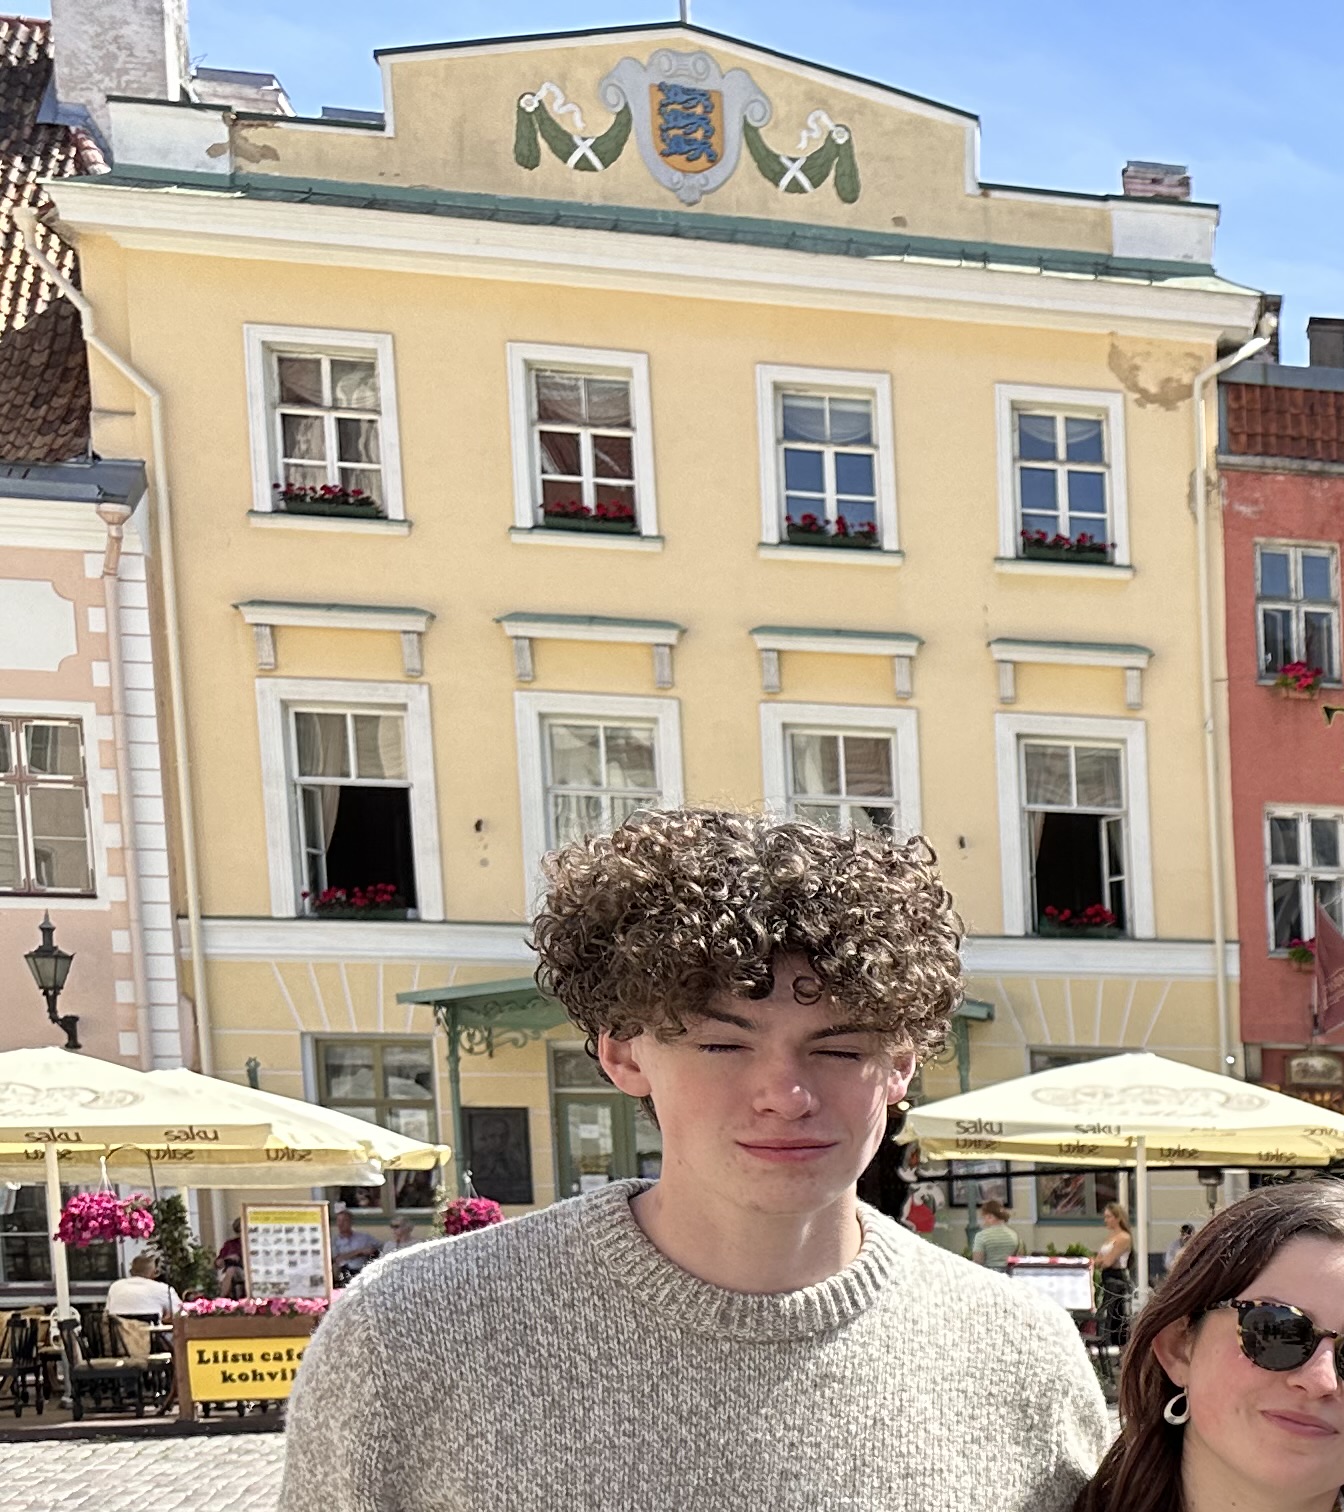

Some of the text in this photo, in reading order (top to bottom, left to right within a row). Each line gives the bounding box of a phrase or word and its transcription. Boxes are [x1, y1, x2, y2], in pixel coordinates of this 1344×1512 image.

[164, 1125, 219, 1142] saku
[955, 1118, 1003, 1136] saku
[197, 1349, 254, 1365] Liisu
